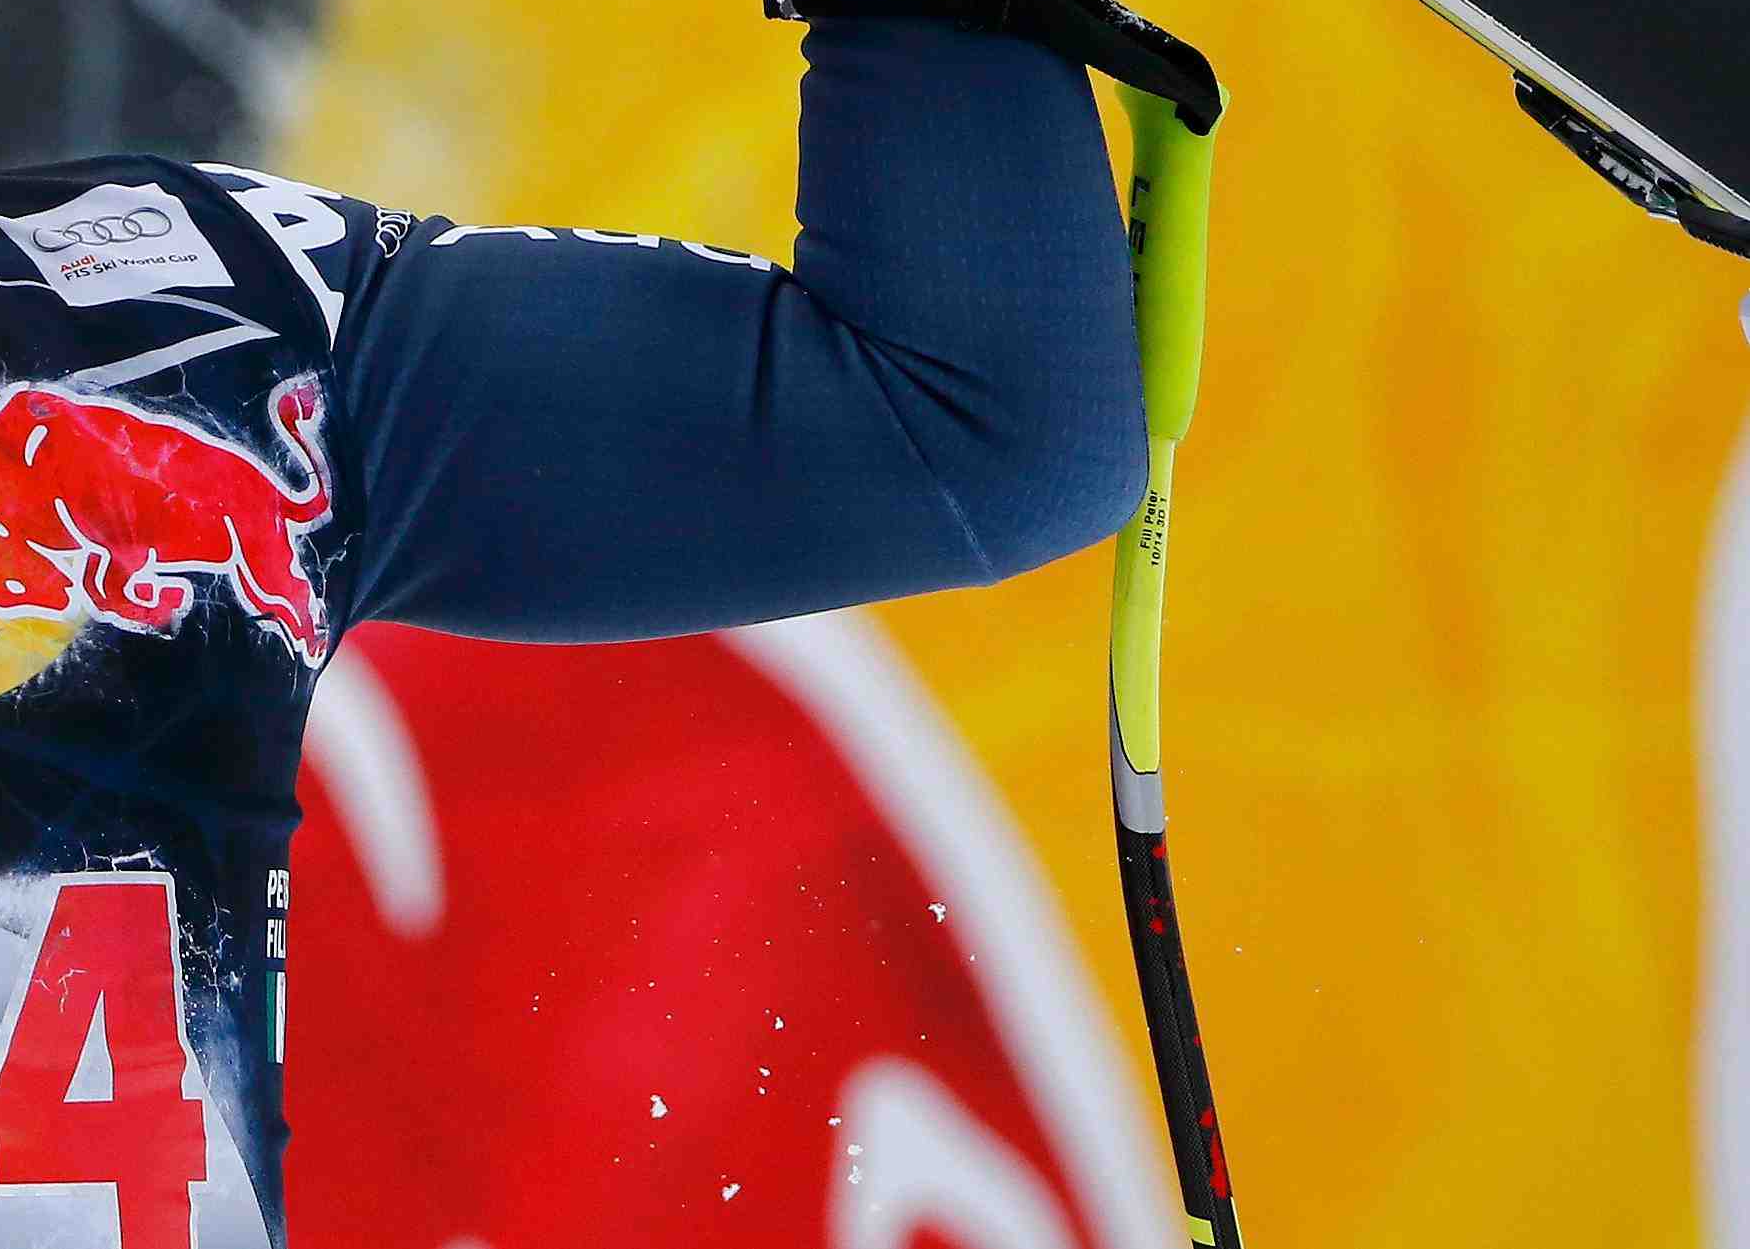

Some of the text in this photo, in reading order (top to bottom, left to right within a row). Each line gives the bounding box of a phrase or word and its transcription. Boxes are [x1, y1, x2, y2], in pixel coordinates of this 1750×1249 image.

[60, 254, 97, 273] Audi
[64, 254, 199, 281] FIS Ski World Cup
